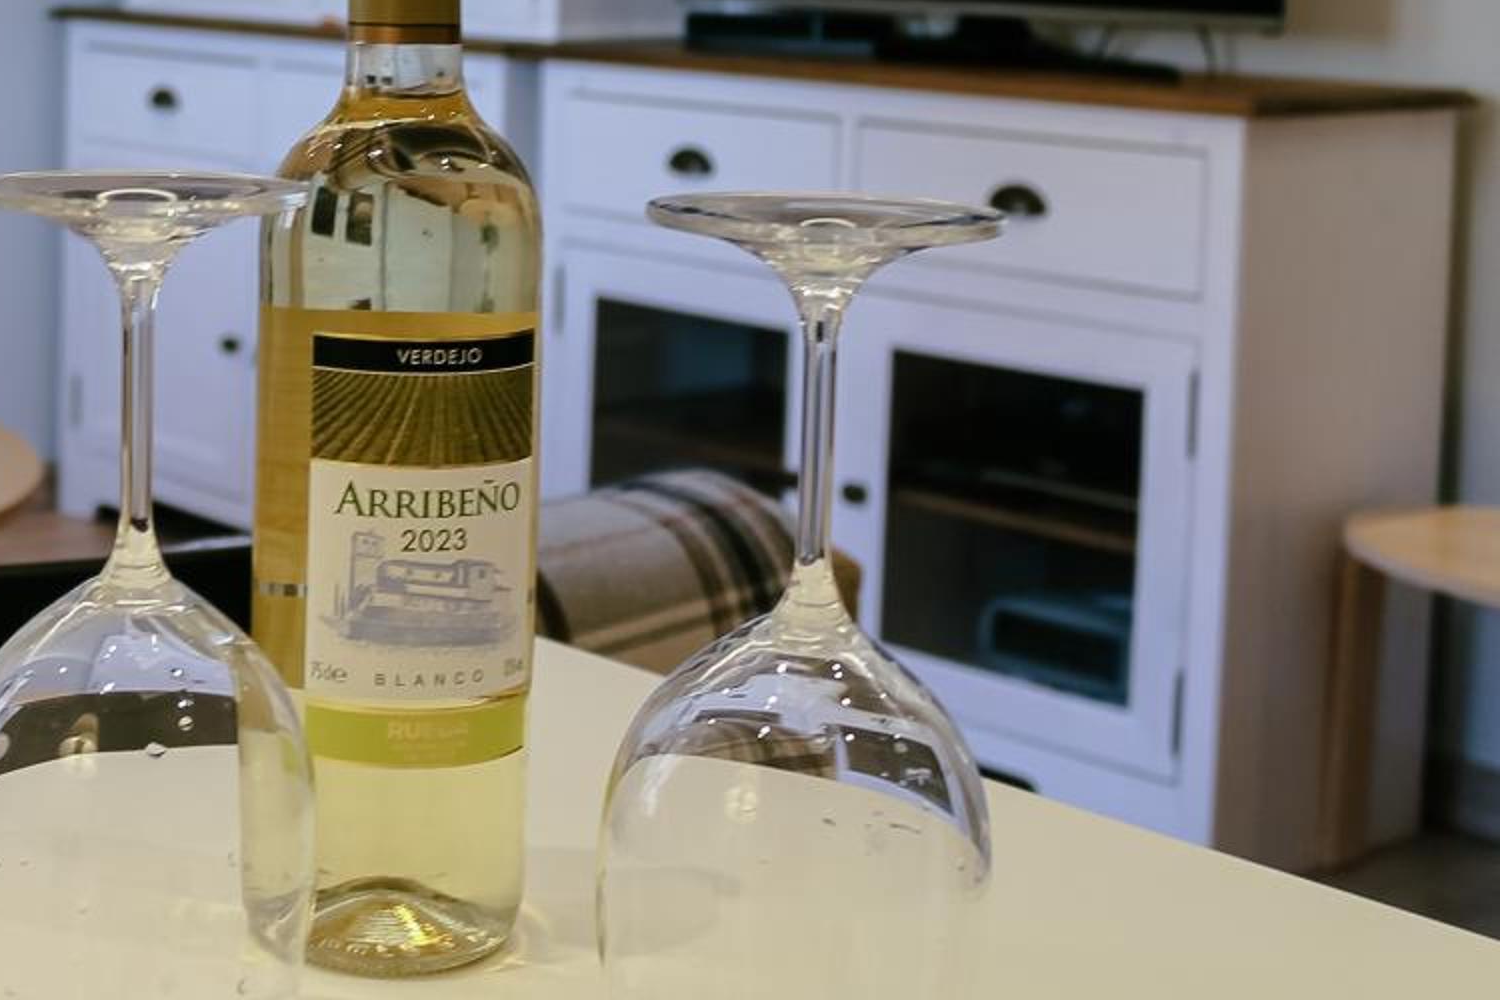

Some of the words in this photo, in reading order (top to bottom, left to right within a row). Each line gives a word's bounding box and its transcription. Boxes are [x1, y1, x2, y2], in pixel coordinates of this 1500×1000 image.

[397, 348, 483, 365] VERDEJO
[334, 479, 521, 519] ARRIBEÑO
[400, 528, 468, 552] 2023
[374, 669, 485, 687] BLANCO
